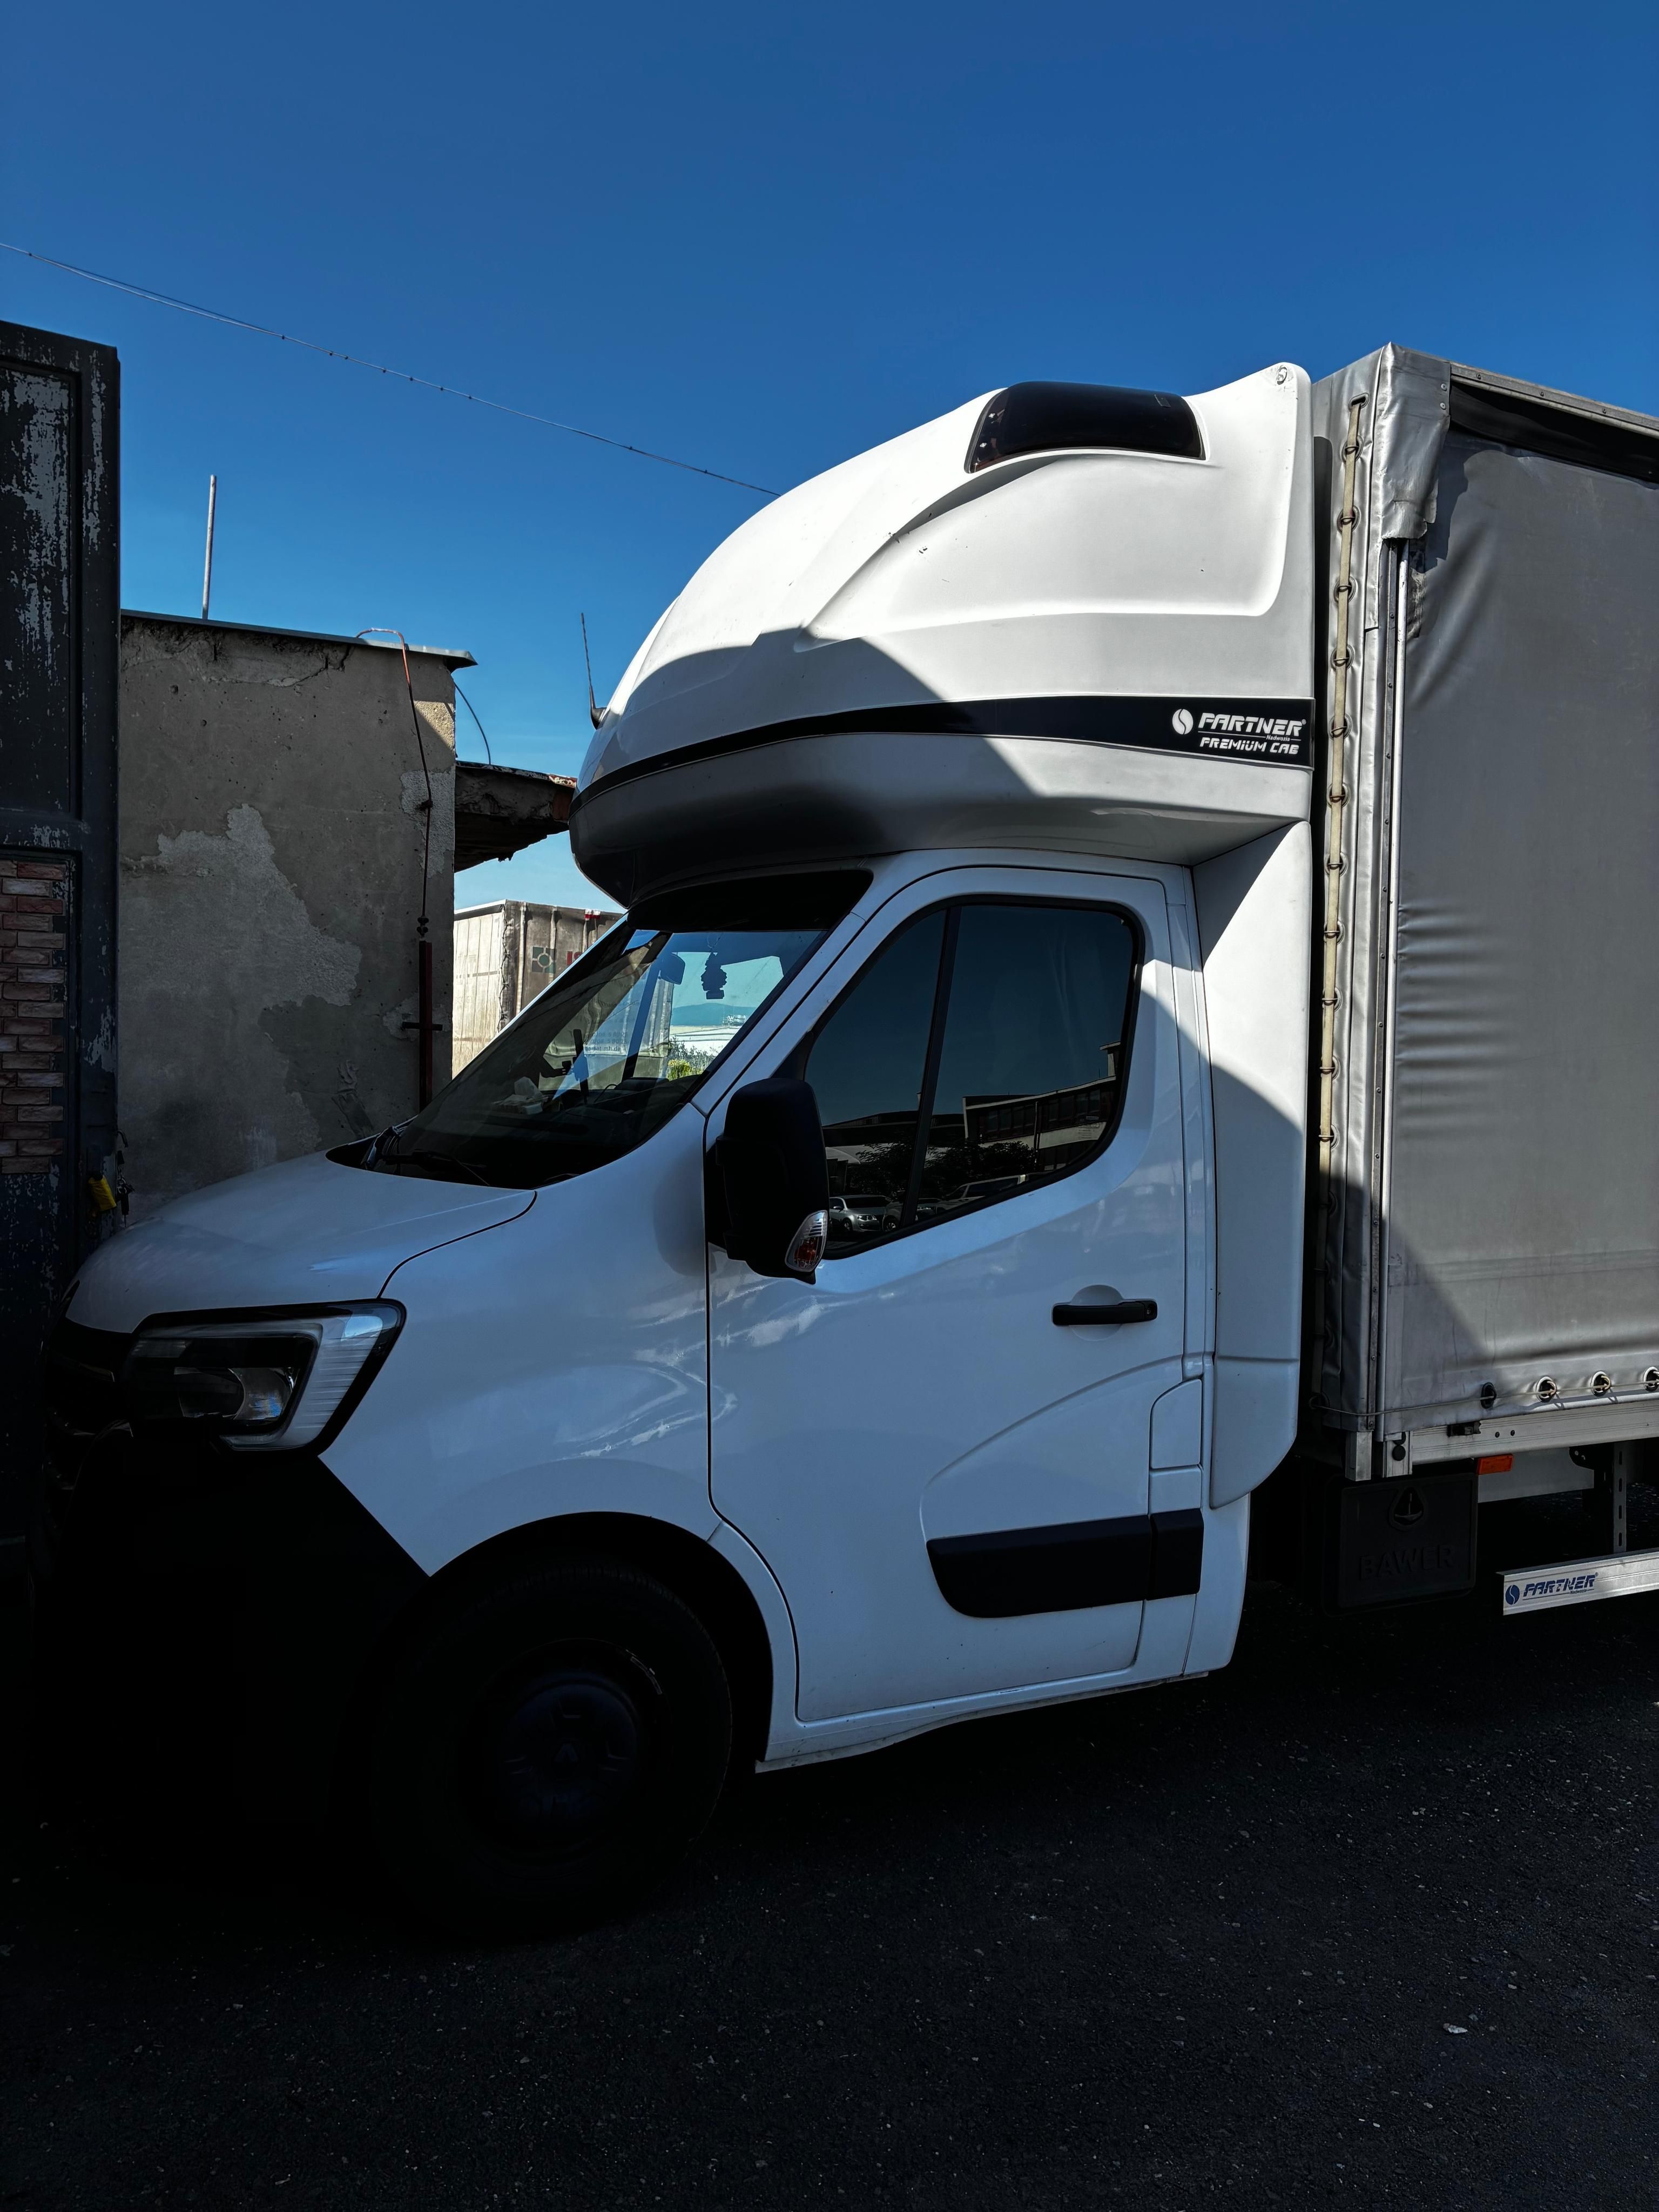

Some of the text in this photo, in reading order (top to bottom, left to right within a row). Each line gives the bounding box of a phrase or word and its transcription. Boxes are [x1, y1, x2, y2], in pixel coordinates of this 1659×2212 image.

[1198, 712, 1303, 737] PARTNER
[1199, 737, 1300, 754] PREMIUM CAB
[1359, 1545, 1455, 1581] BAWER
[1523, 1574, 1596, 1597] PARTNER
